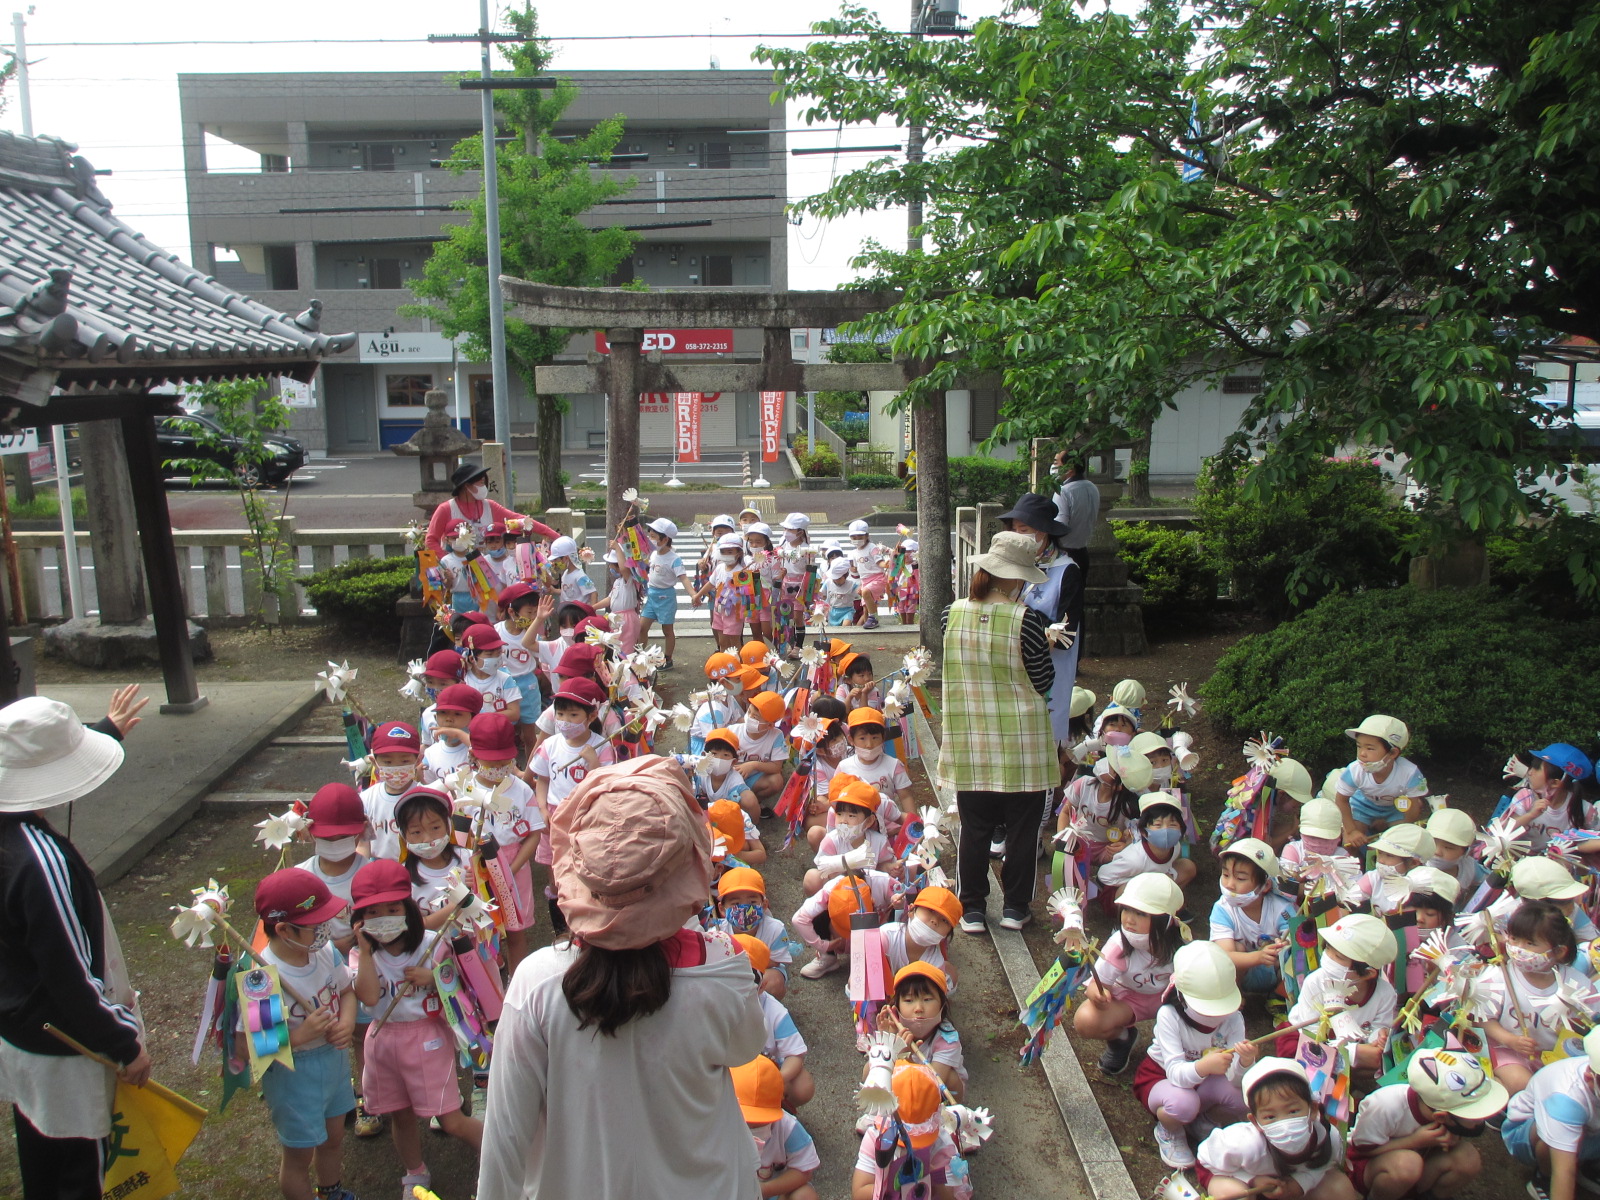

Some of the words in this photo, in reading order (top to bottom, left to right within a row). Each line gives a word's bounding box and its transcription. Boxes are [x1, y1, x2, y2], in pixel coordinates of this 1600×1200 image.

[641, 334, 676, 350] ED
[678, 405, 691, 453] RED
[764, 405, 776, 452] RED
[1132, 972, 1171, 989] SHIO
